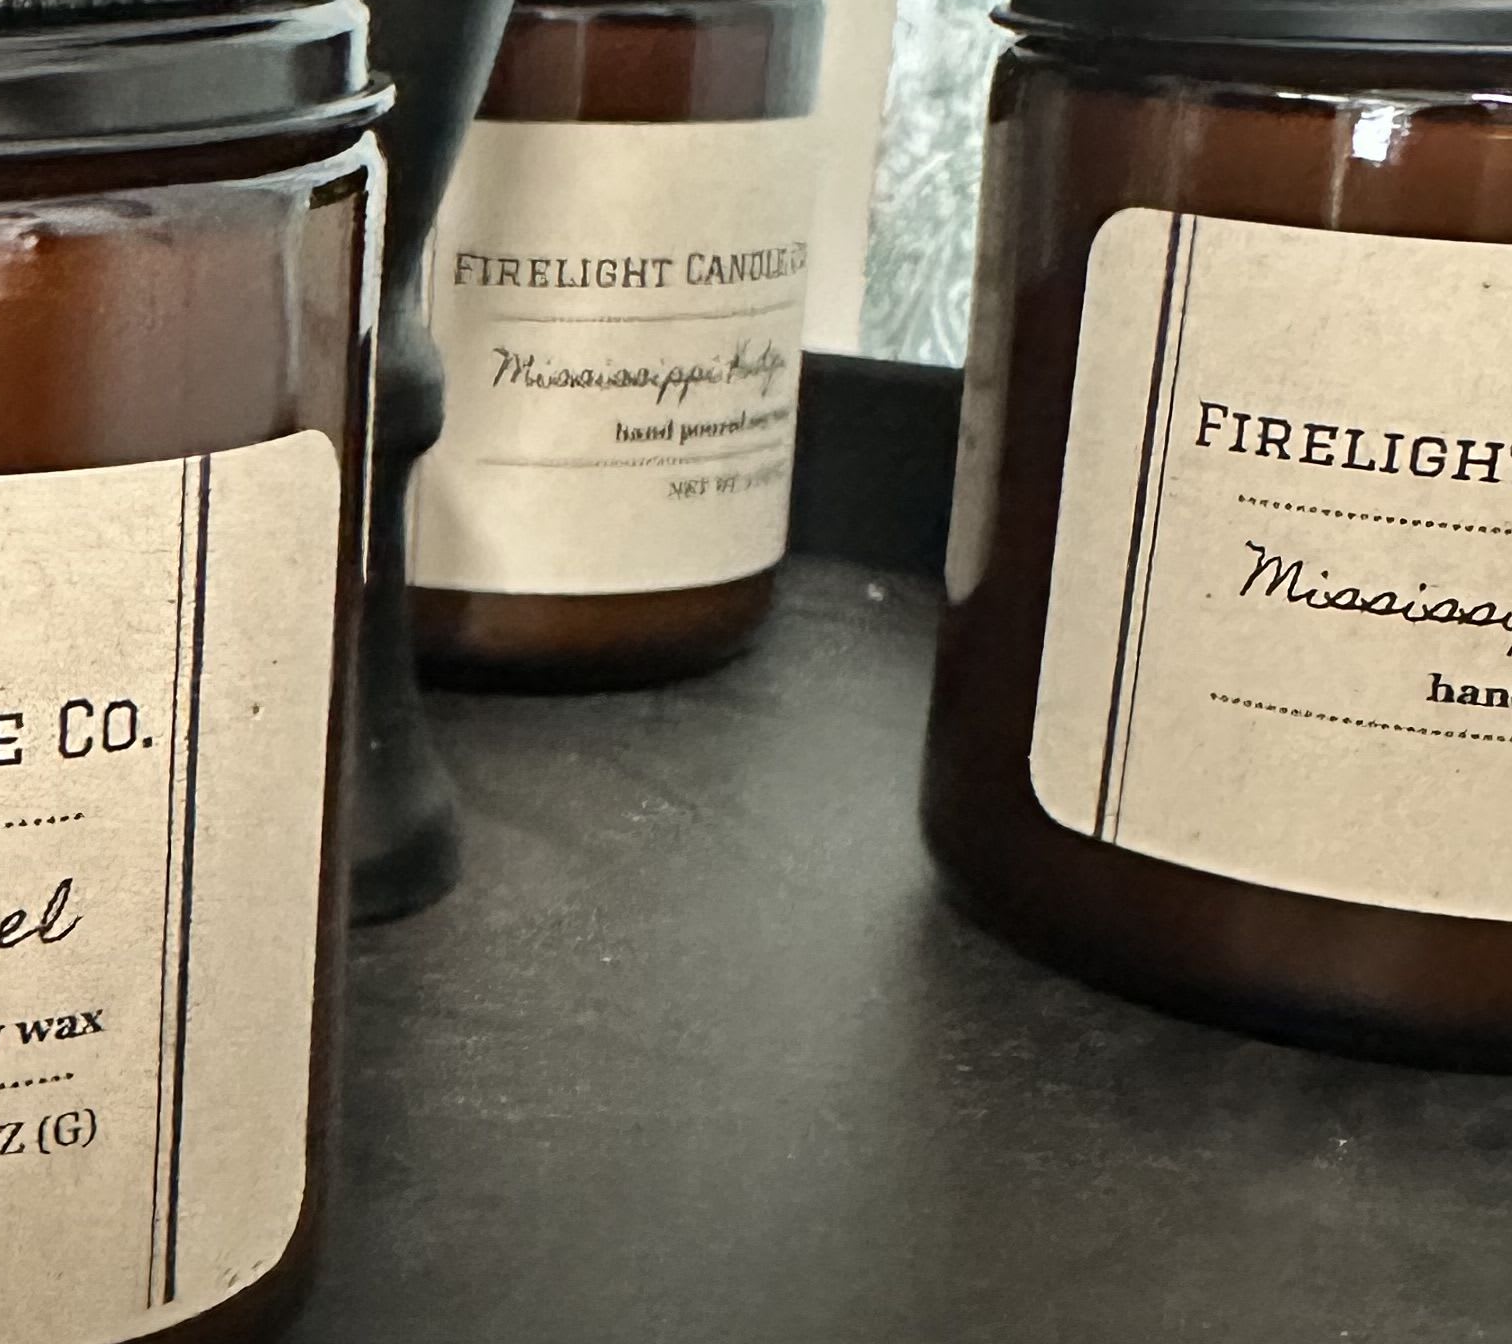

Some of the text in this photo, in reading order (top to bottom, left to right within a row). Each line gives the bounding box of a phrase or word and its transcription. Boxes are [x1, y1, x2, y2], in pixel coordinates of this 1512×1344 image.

[454, 250, 672, 289] FIRELIGHT
[1194, 399, 1512, 484] FIRELIGH
[1426, 672, 1512, 709] han
[58, 698, 154, 760] CO.
[14, 1006, 107, 1045] wax
[35, 1107, 98, 1156] (G)
